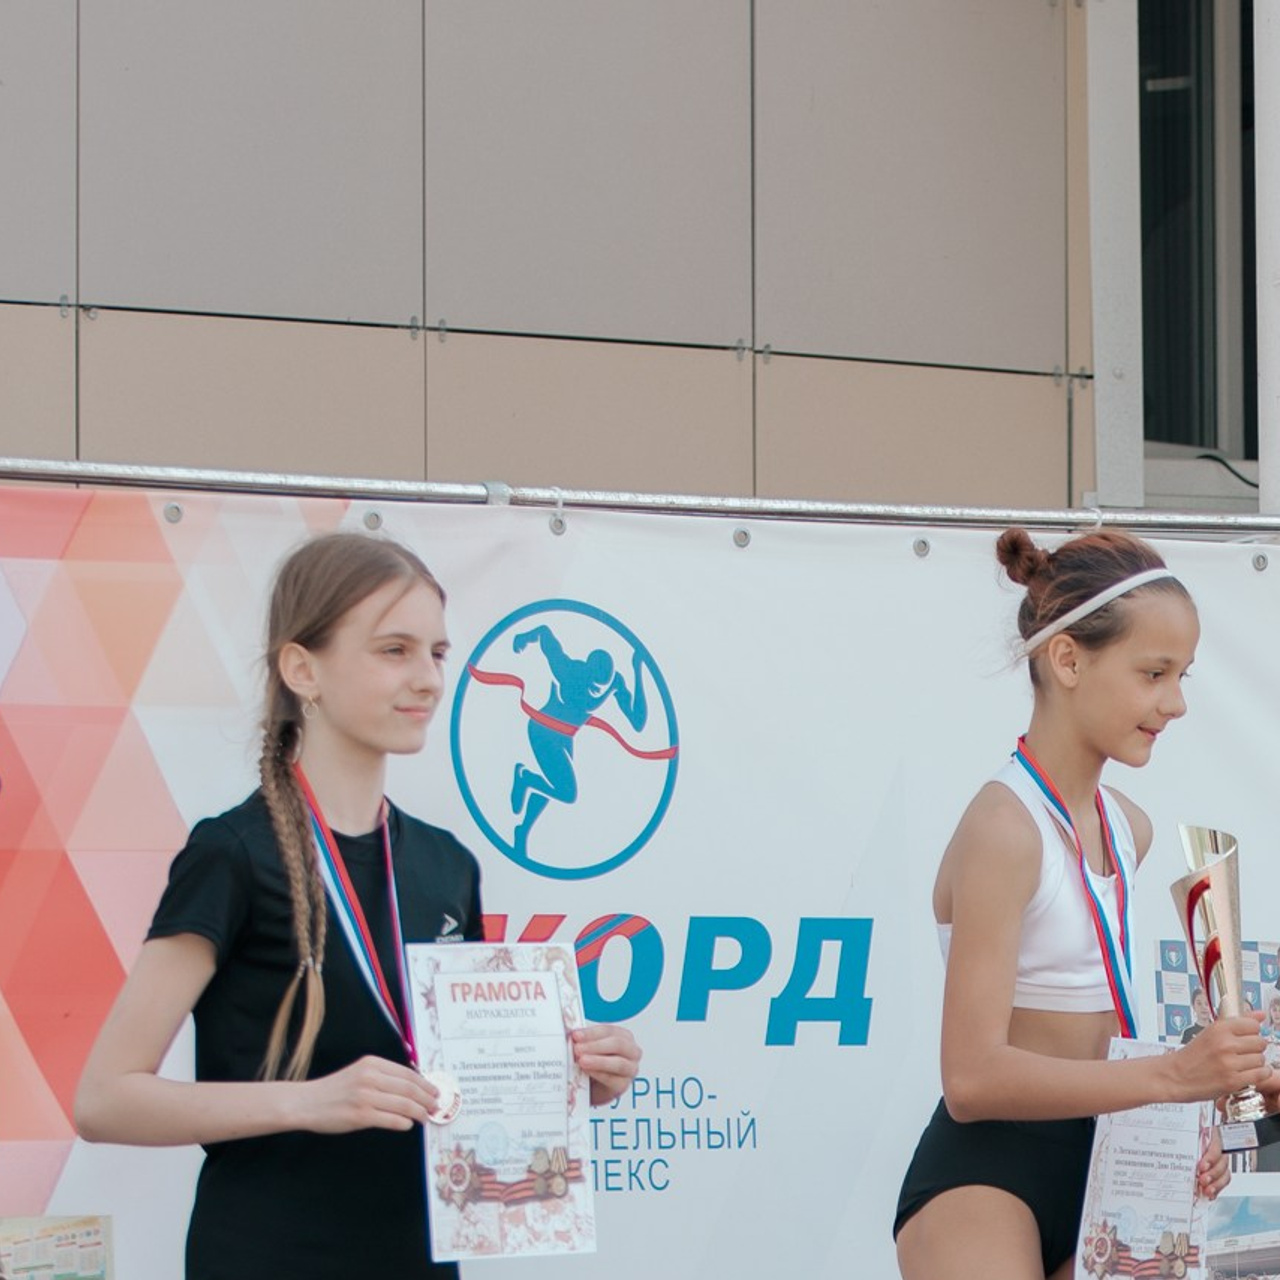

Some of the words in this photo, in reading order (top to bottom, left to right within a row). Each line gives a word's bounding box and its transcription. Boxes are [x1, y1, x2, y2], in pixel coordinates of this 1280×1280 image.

[450, 981, 547, 1003] ГРАМОТА
[482, 914, 874, 1046] ОРД
[589, 1110, 757, 1150] ТЕЛЬНЫЙ
